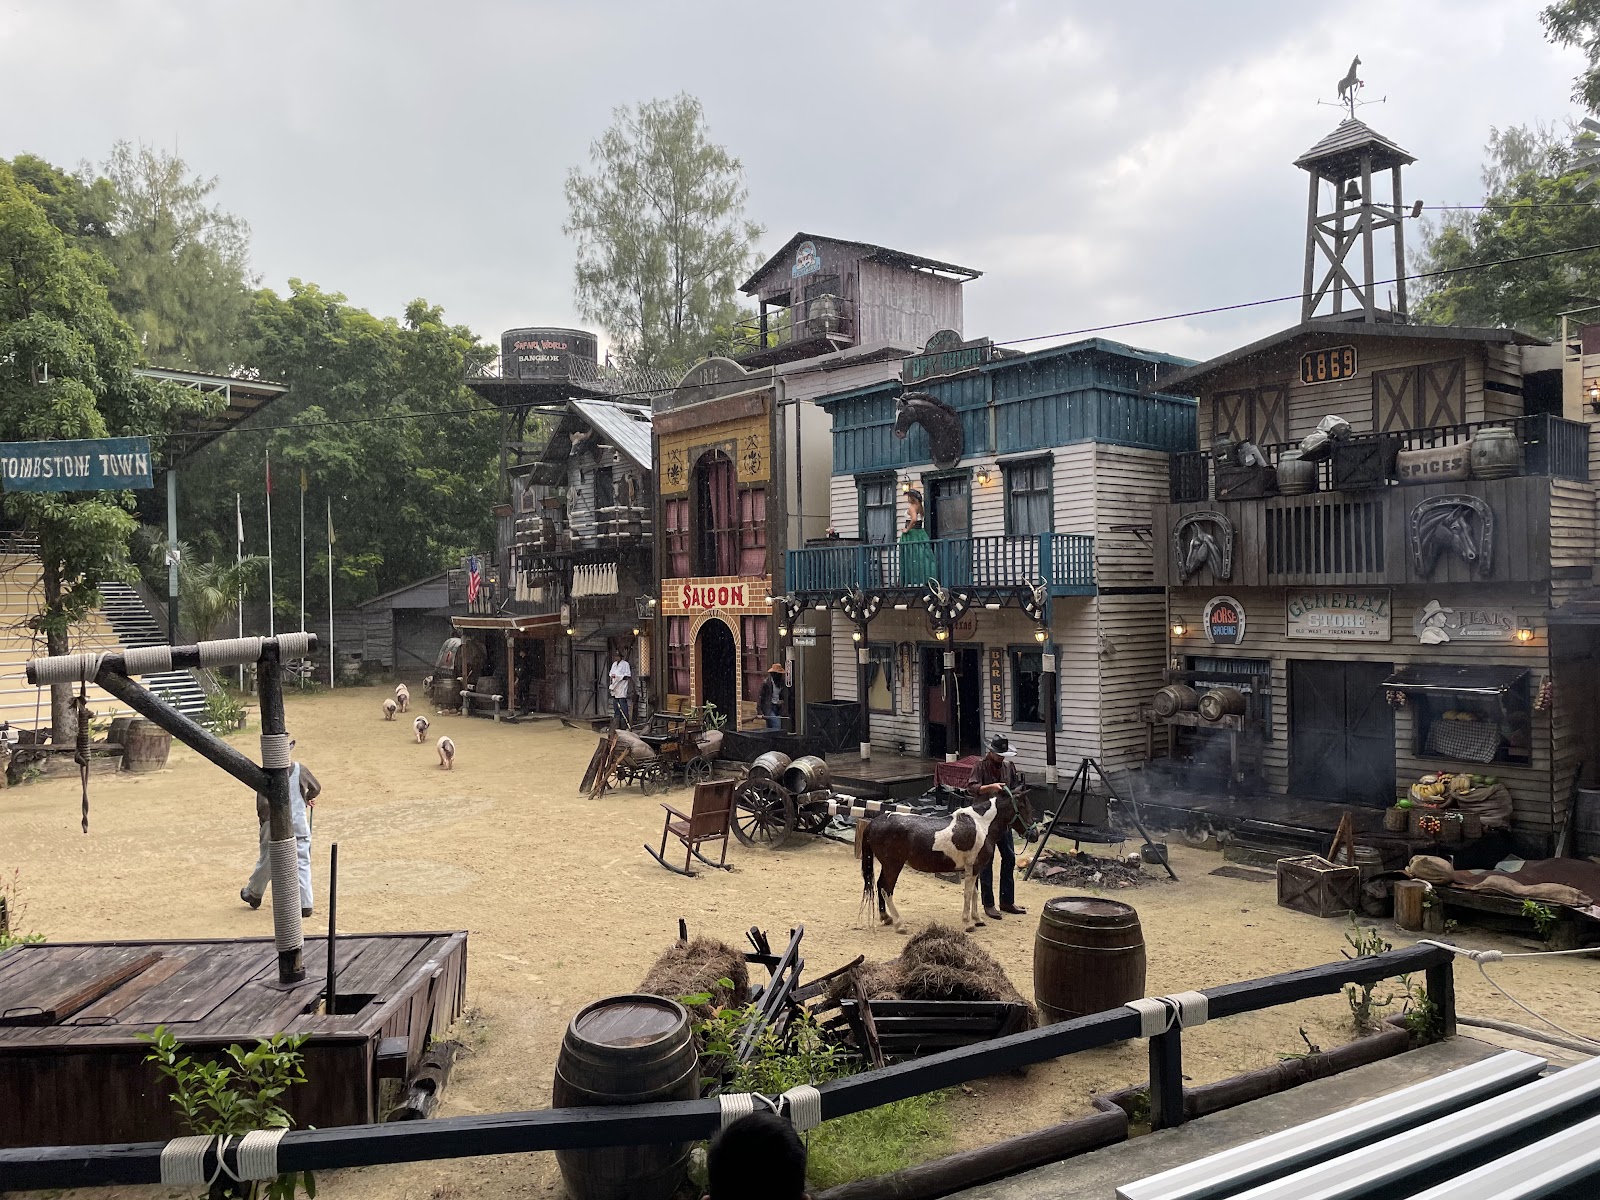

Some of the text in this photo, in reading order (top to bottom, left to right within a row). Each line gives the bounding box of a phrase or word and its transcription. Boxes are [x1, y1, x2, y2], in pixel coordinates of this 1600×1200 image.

[541, 340, 567, 350] WORLD
[519, 354, 559, 362] BANGKOK
[1306, 350, 1353, 382] 1869
[0, 453, 148, 478] TOMBSTONE TOWN
[1401, 458, 1463, 477] SPICES
[682, 584, 745, 609] SALOON
[1288, 593, 1389, 618] GENERAL
[1211, 607, 1238, 624] HORSE
[1308, 614, 1366, 628] STORE
[1455, 611, 1512, 631] HATS
[1212, 625, 1236, 636] SHOEING
[991, 651, 1003, 719] BAR BEER
